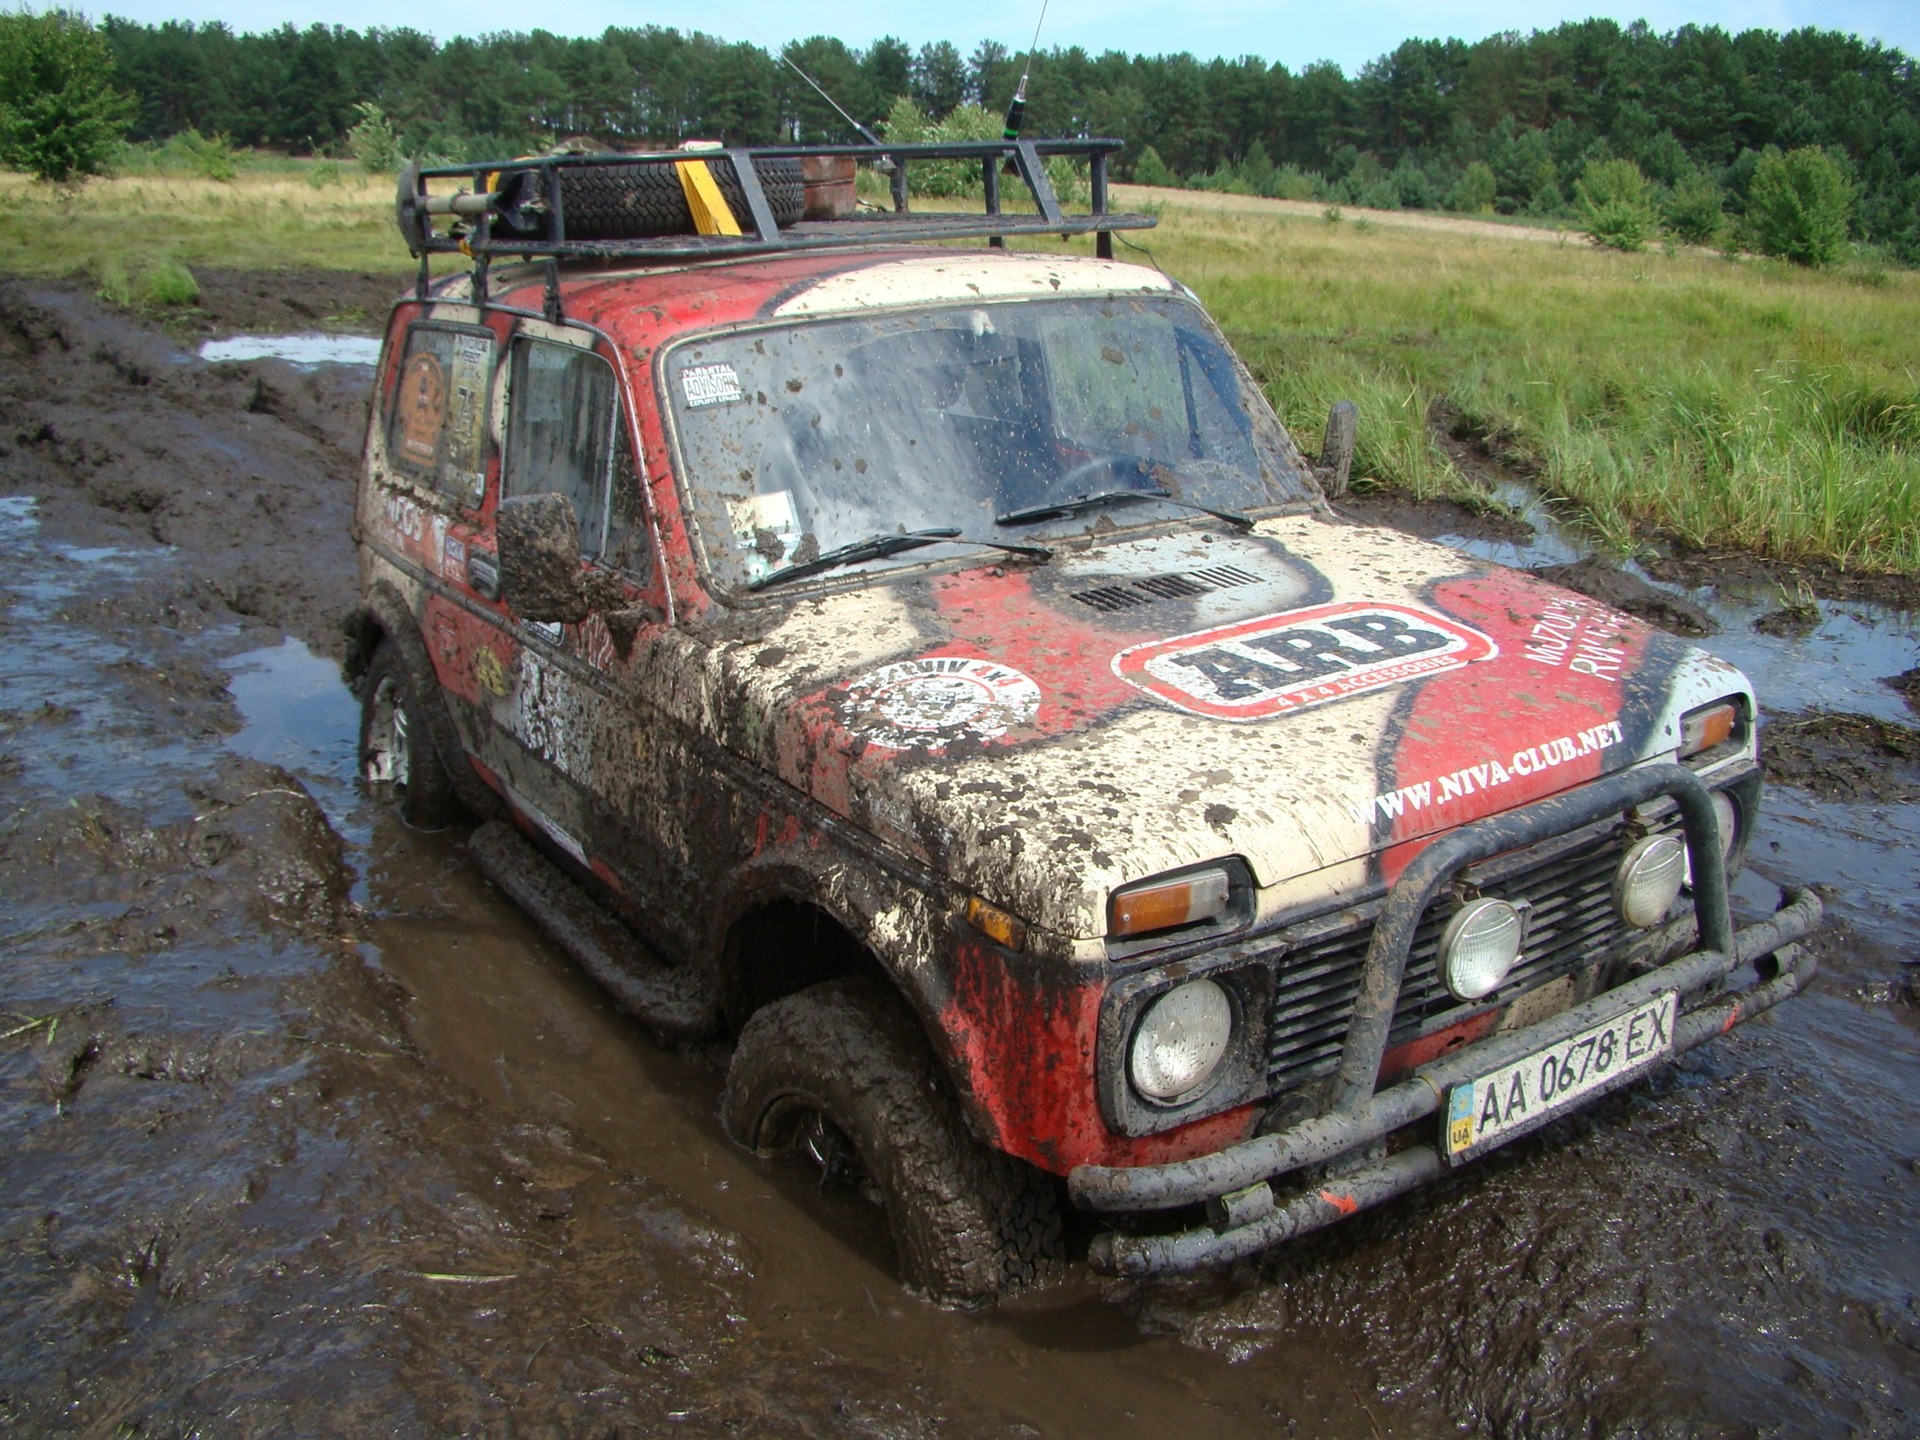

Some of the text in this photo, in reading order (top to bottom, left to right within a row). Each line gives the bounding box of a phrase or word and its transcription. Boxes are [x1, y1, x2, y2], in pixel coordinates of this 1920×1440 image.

[682, 364, 732, 378] PARENTAL
[687, 375, 738, 398] ADVISORY
[1171, 615, 1451, 700] ARB
[1338, 655, 1456, 691] ACCESSORIES
[1350, 721, 1624, 825] WWW.NIVA-CLUB.NET
[1476, 1001, 1670, 1133] AA 0678 EX
[1453, 1126, 1469, 1143] UA
